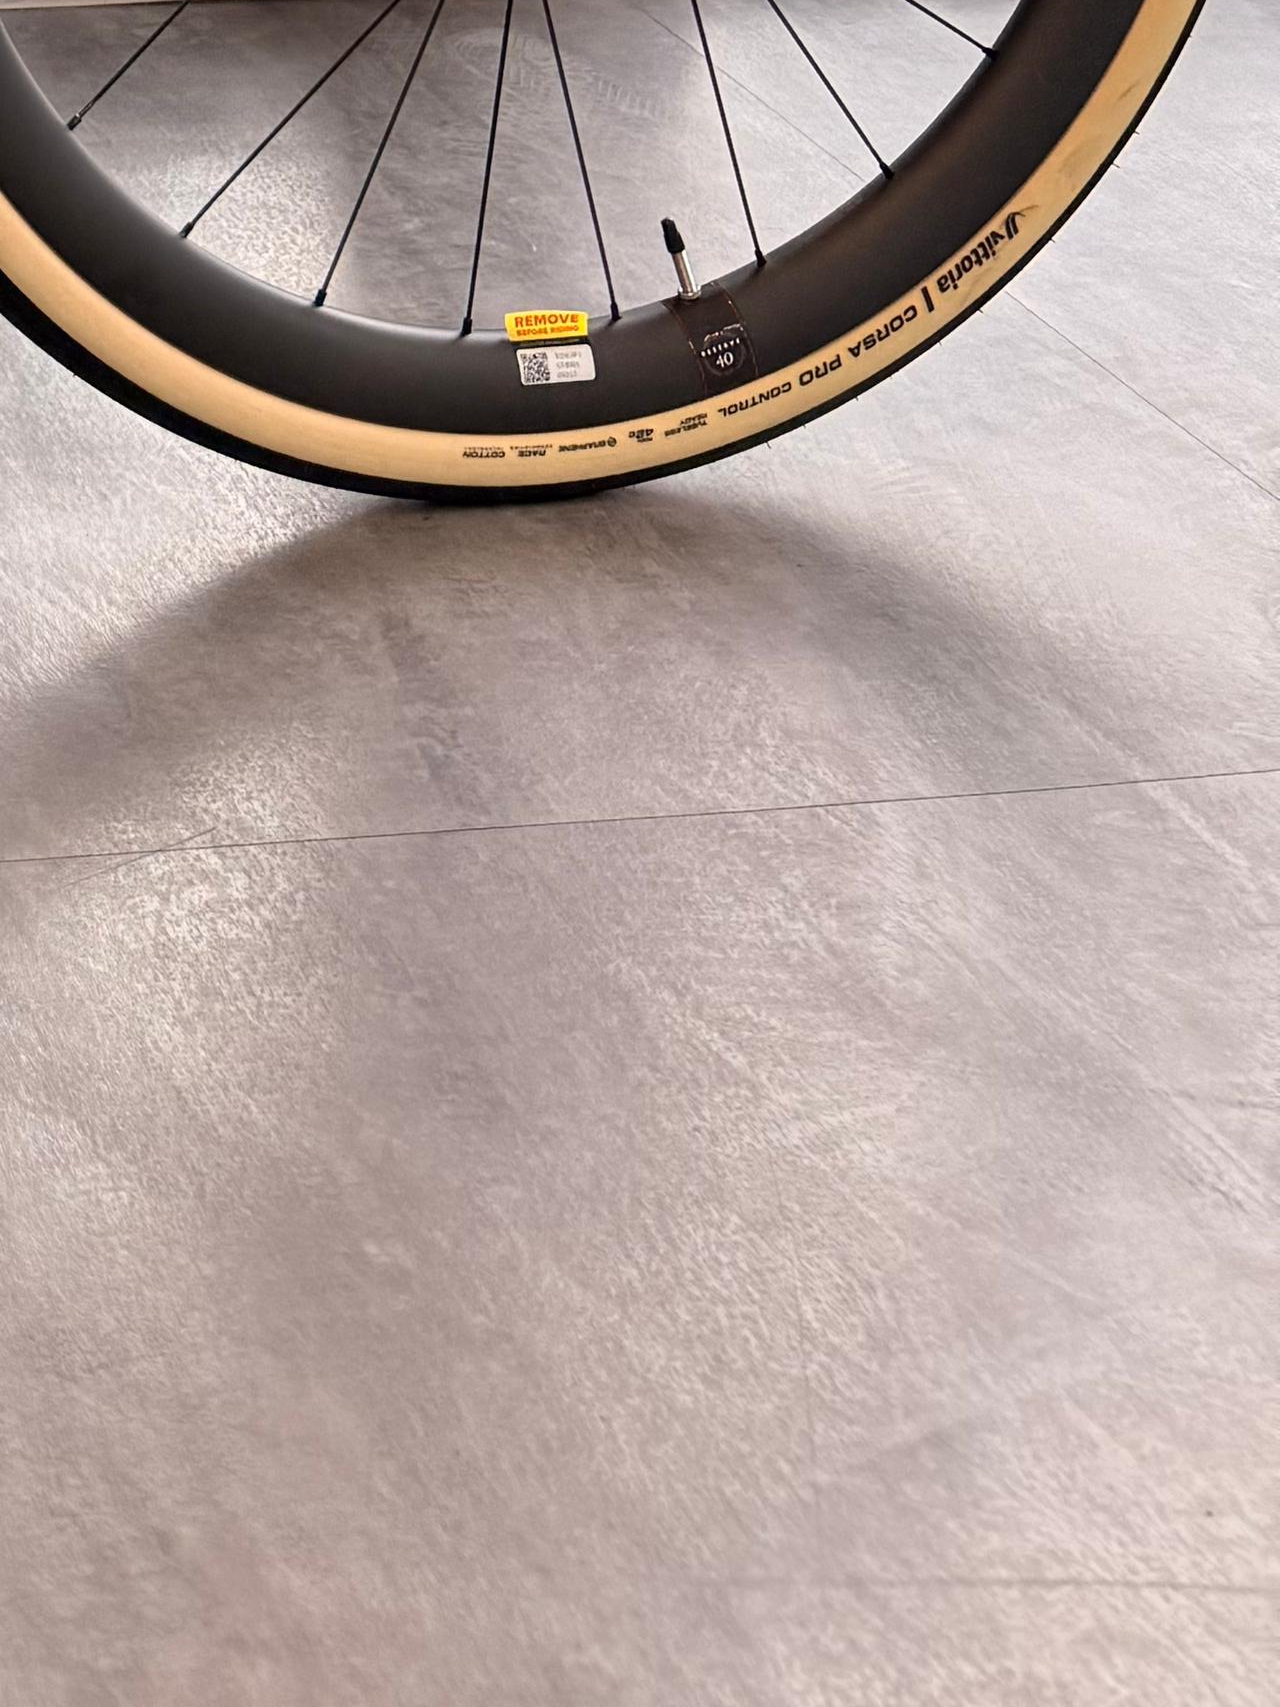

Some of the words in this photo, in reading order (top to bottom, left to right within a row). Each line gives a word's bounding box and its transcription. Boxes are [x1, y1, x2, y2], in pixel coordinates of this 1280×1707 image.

[938, 217, 1018, 294] vittoria
[513, 313, 580, 329] REMOVE
[847, 304, 918, 359] CORSA
[716, 351, 735, 368] 40
[799, 353, 843, 387] PRO
[717, 381, 793, 418] CONTROL
